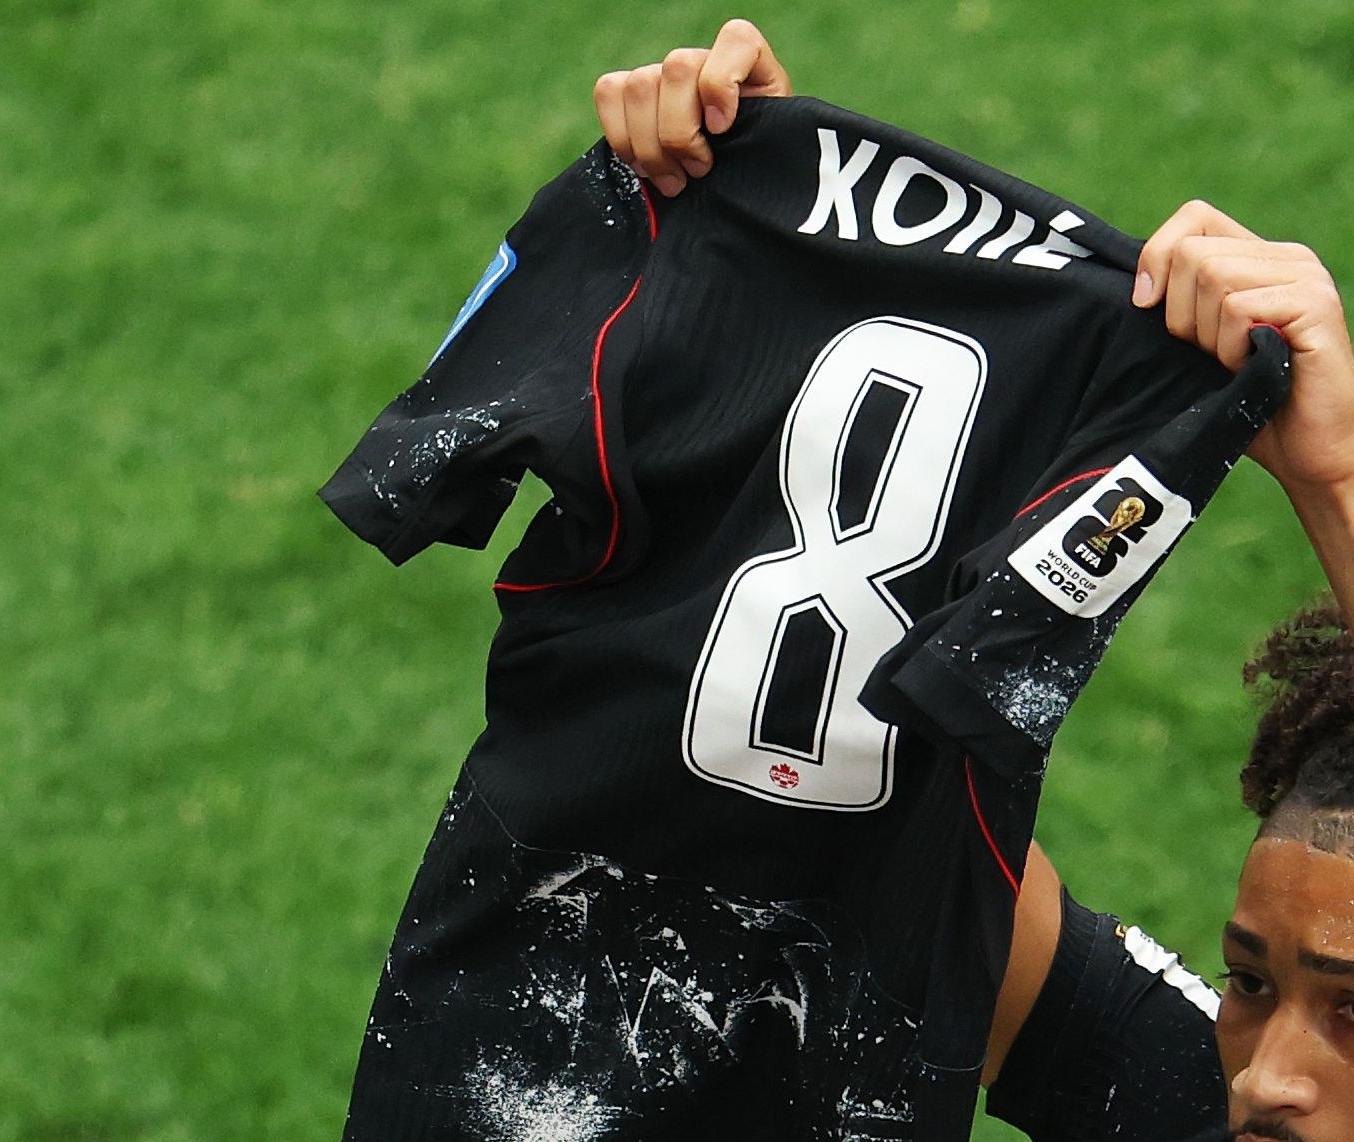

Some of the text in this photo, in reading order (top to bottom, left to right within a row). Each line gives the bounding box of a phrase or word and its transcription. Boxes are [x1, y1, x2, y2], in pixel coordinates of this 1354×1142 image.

[682, 315, 989, 811] 8
[1047, 549, 1097, 591] WORLD CUP
[1074, 542, 1102, 569] FIFA
[1035, 559, 1089, 604] 2026
